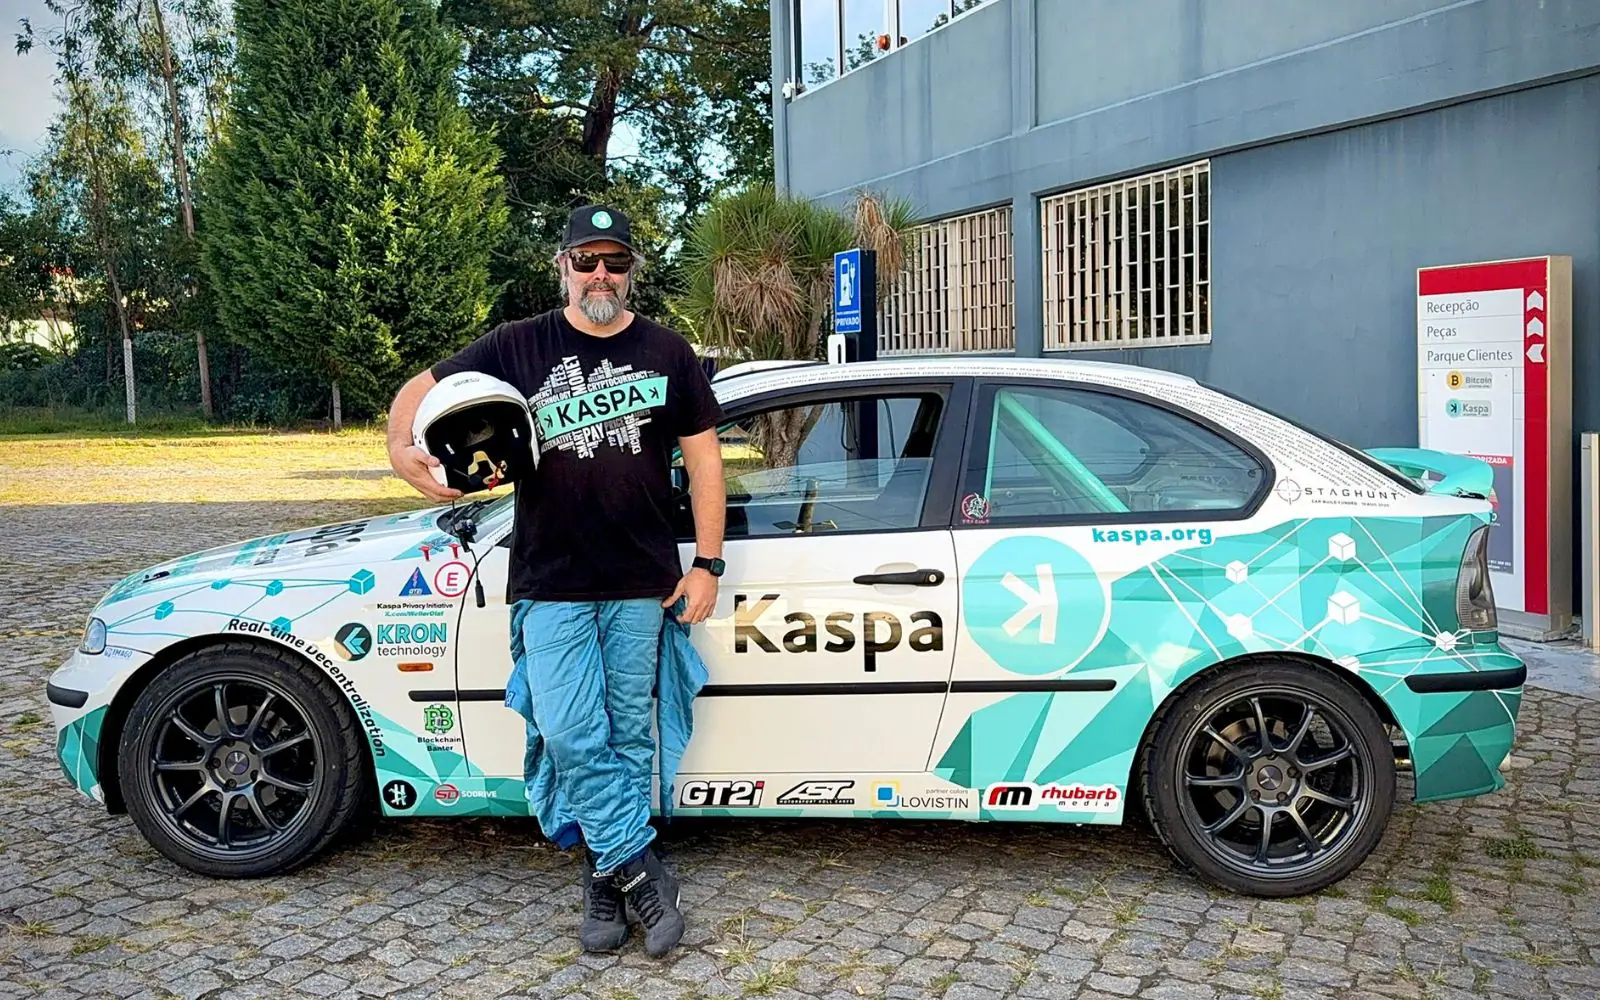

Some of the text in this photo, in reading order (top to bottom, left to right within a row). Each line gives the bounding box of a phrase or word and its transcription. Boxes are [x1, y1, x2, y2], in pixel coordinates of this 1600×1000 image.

[1427, 299, 1480, 315] Recepção
[836, 317, 859, 327] PRIVADO
[1427, 326, 1457, 340] Peças
[1427, 349, 1513, 364] Parque Clientes
[552, 364, 569, 388] FEES
[562, 355, 588, 397] MONEY
[587, 370, 648, 392] CRYPTOCURRENCY
[1465, 376, 1492, 384] Bitcoin
[556, 385, 647, 428] KASPA
[1463, 403, 1489, 415] Kaspa
[582, 422, 605, 443] PAY
[624, 413, 642, 455] EXCHANGE
[572, 430, 589, 459] SMART
[1092, 528, 1213, 546] kaspa.org
[377, 623, 447, 645] KRON
[734, 594, 944, 672] Kaspa
[378, 645, 447, 658] technology
[228, 618, 386, 758] Real-time Decentralization
[679, 781, 765, 808] GT2i
[901, 796, 969, 809] LOVISTIN
[1041, 786, 1118, 800] rhubarb
